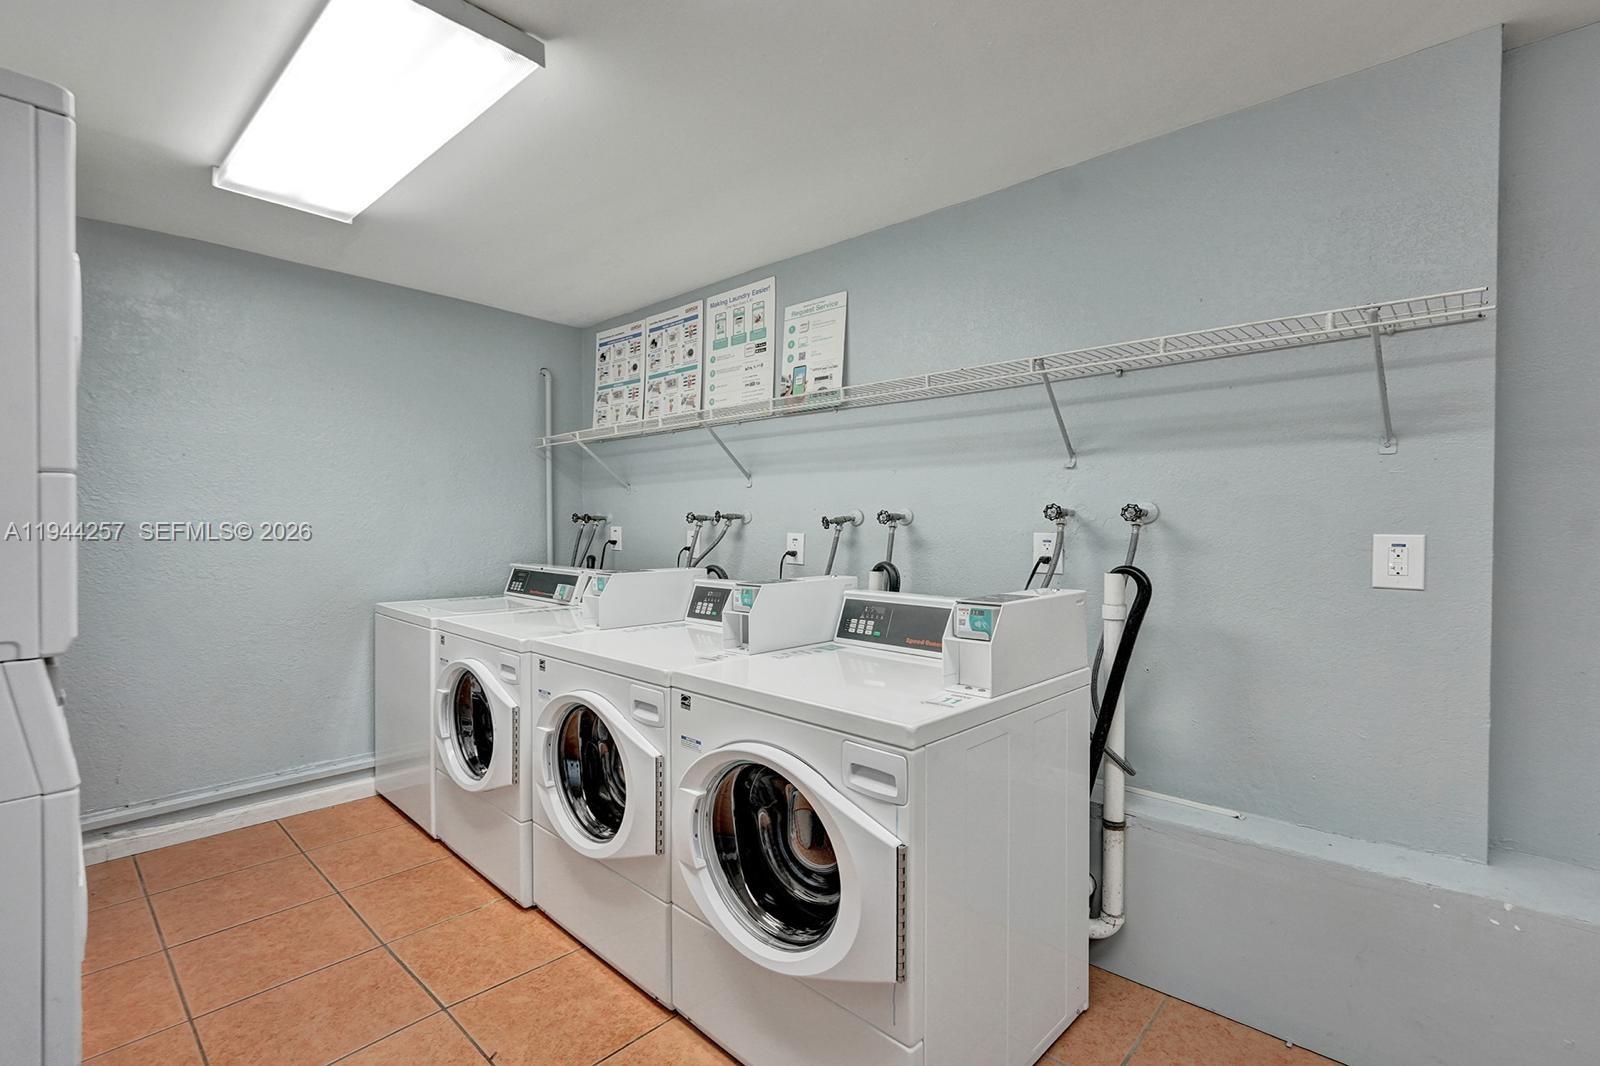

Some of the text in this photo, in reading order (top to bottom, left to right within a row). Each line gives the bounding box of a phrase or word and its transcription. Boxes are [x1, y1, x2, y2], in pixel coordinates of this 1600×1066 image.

[709, 299, 728, 308] Making
[728, 292, 751, 303] Laundry
[791, 305, 815, 316] Request
[815, 301, 839, 311] Service
